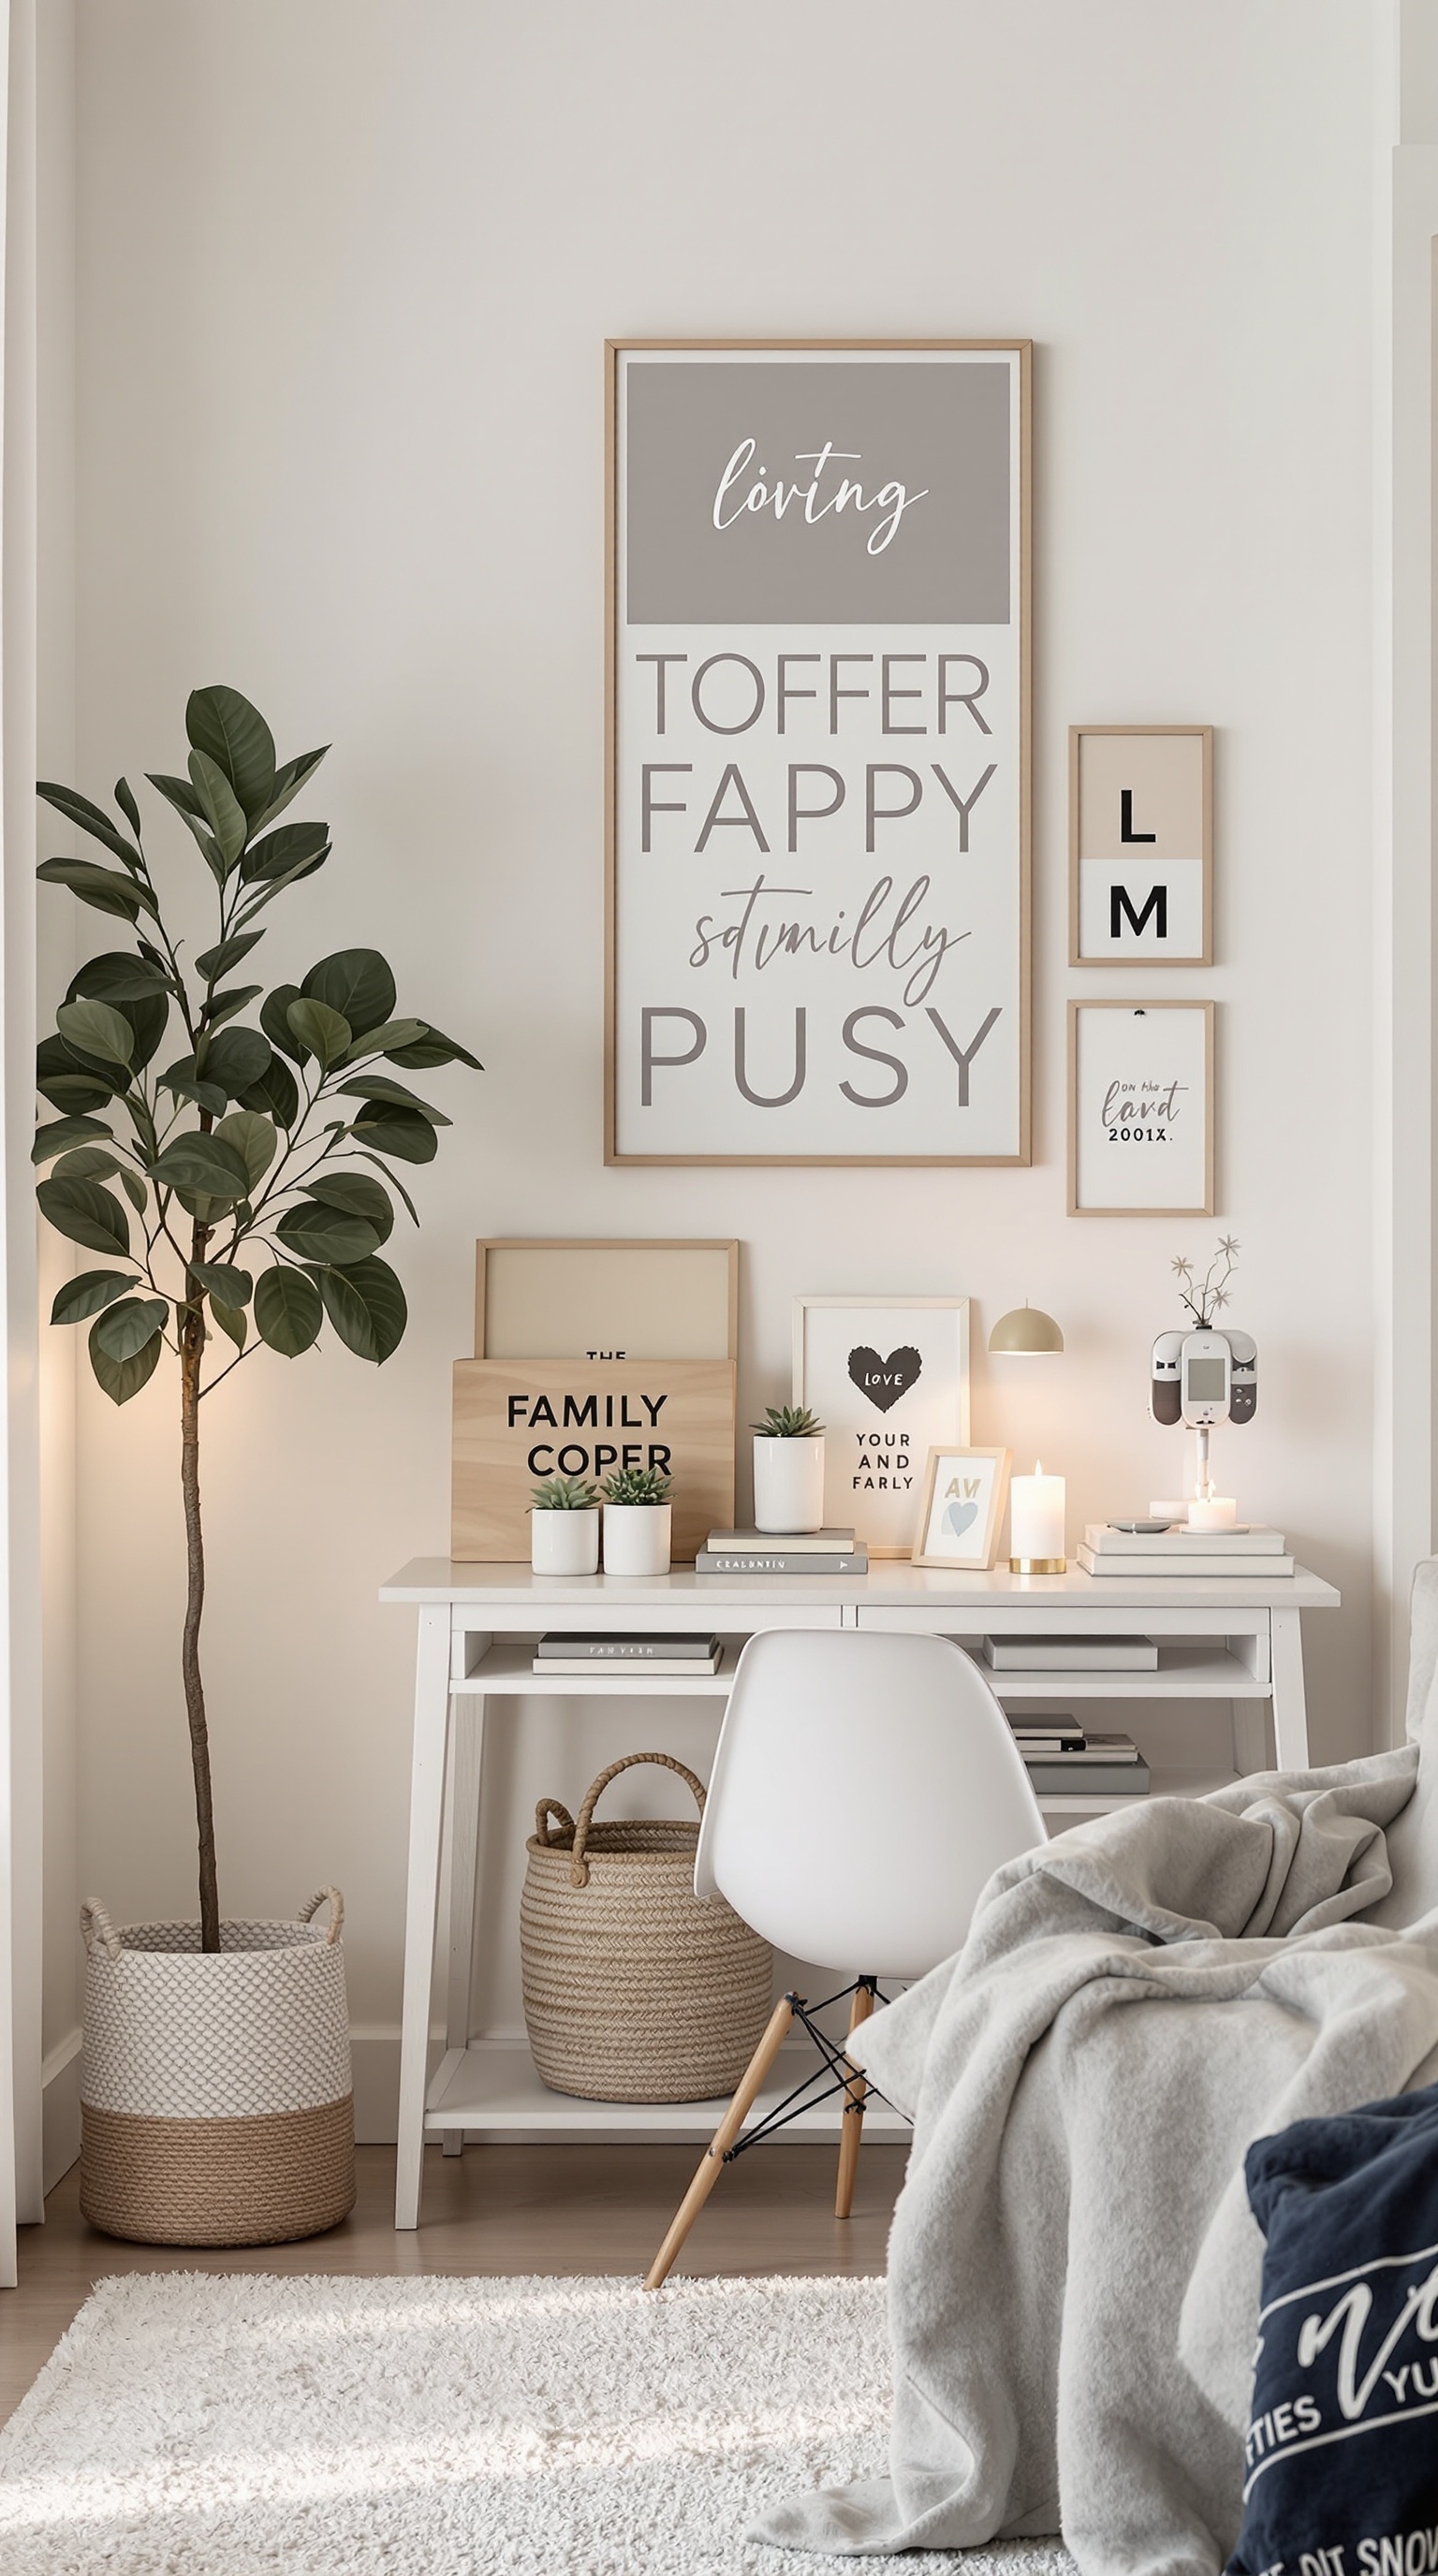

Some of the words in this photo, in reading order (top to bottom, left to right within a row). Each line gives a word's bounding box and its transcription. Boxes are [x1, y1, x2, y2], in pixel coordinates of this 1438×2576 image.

[636, 652, 993, 735] TOFFER
[641, 763, 999, 853] FAPPY
[1121, 789, 1156, 842] L
[1110, 886, 1167, 938] M
[640, 1005, 1004, 1108] PUSY
[865, 1372, 903, 1386] LOVE
[507, 1395, 668, 1427] FAMILY
[856, 1433, 910, 1447] YOUR
[527, 1444, 672, 1477] COPER
[858, 1455, 909, 1469] AND
[853, 1476, 913, 1489] FARLY
